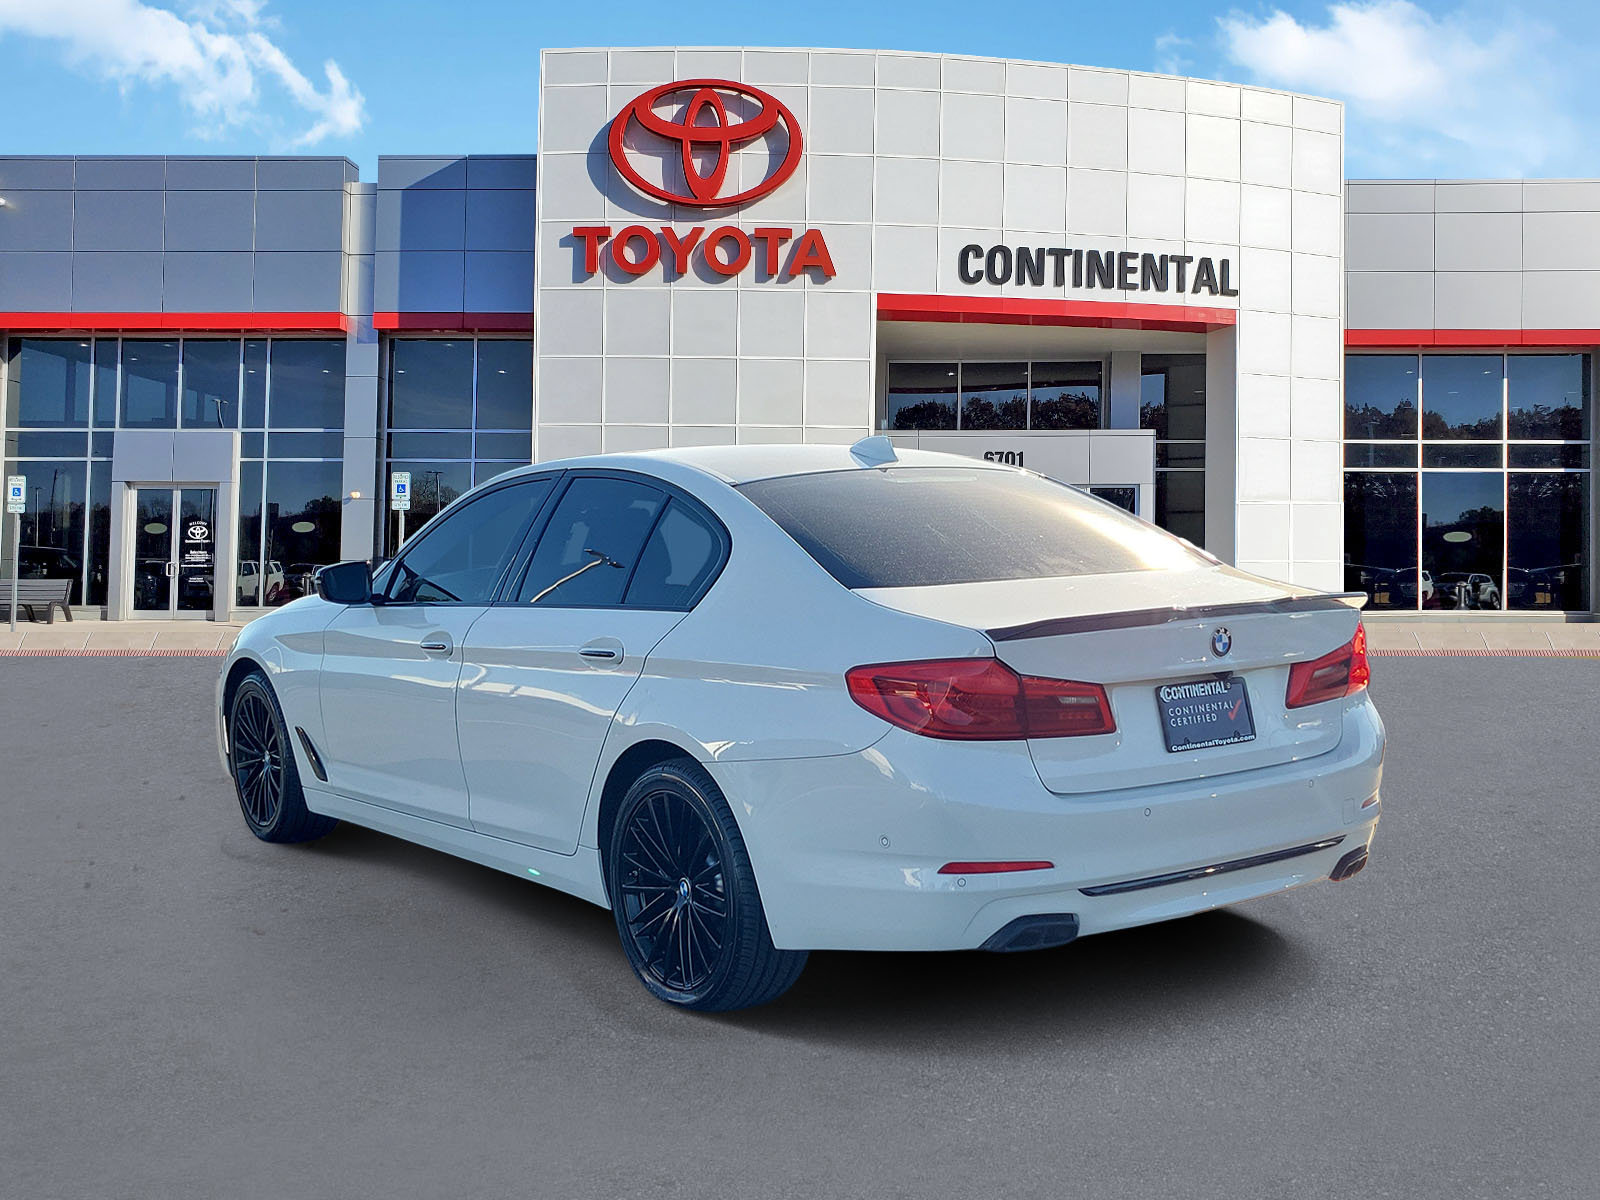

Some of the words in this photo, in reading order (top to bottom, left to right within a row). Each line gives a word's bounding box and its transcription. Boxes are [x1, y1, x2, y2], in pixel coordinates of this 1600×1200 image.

[573, 225, 837, 277] TOYOTA
[958, 244, 1239, 297] CONTINENTAL
[1162, 681, 1228, 702] CONTINENTAL
[1168, 701, 1234, 717] CONTINENTAL
[1170, 713, 1217, 727] CERTIFIED
[1171, 735, 1255, 751] ContinentalToyota.com
